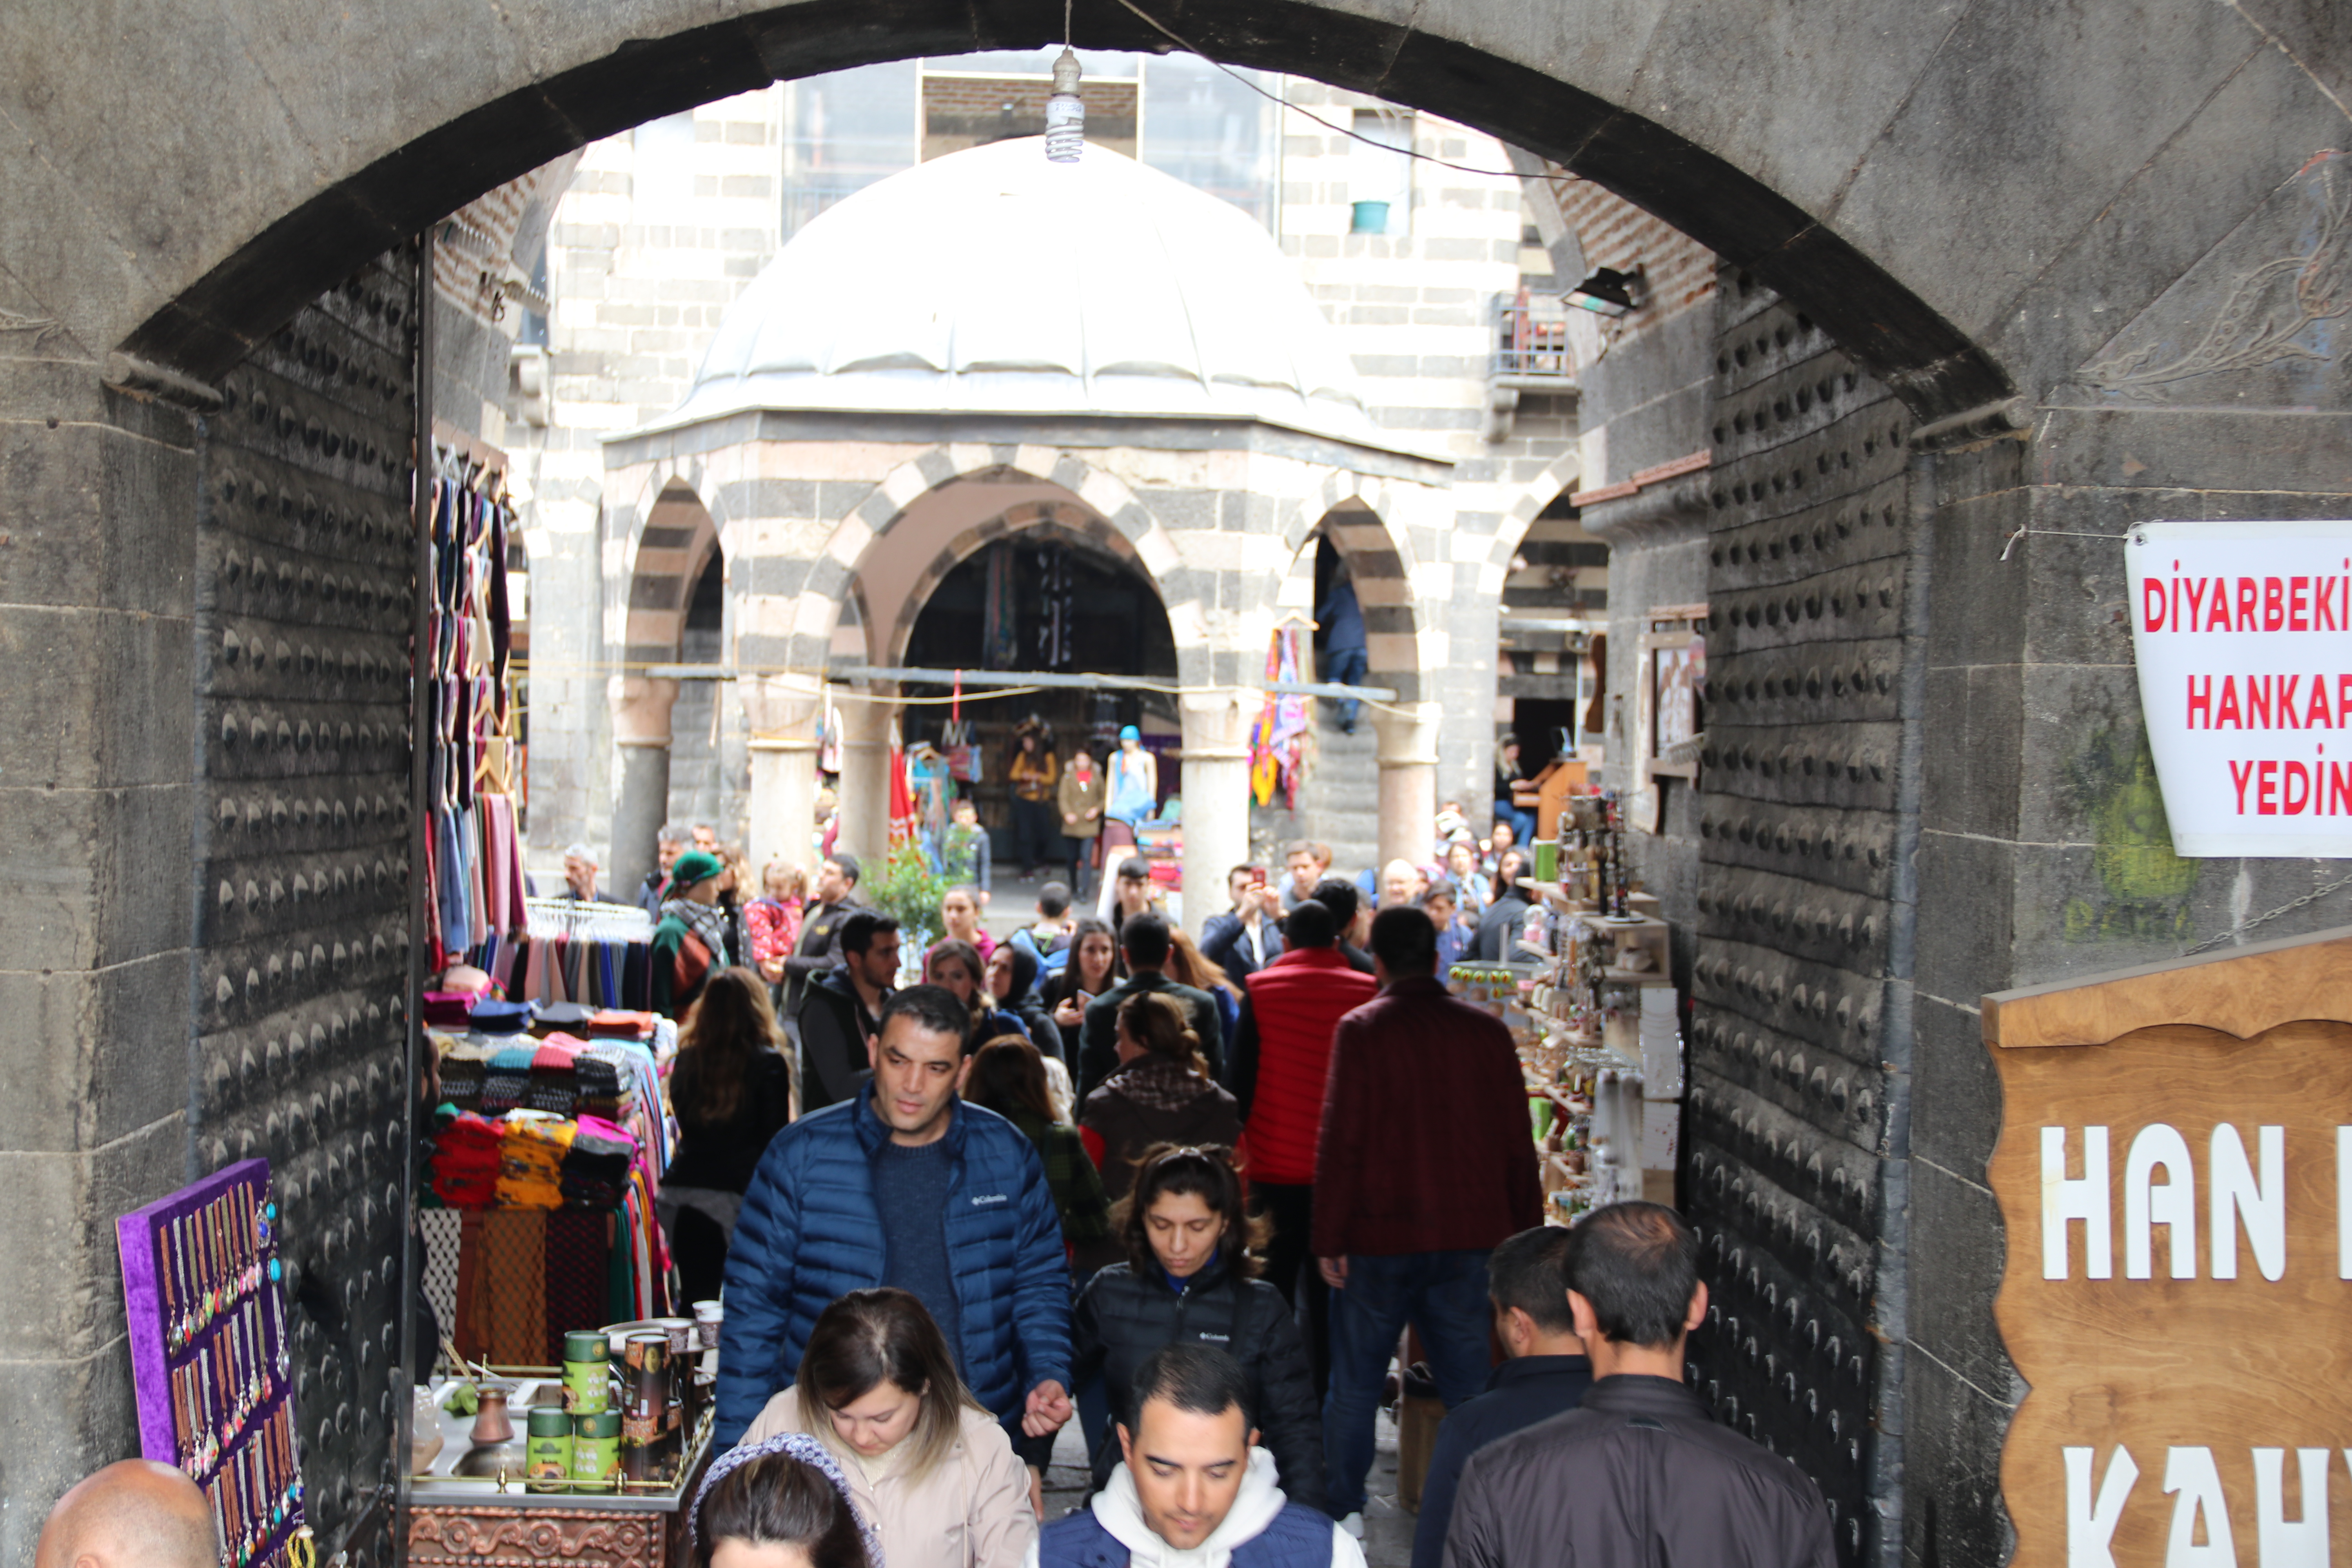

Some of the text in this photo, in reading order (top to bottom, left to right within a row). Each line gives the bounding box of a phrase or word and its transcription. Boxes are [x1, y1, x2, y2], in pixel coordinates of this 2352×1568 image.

[2143, 558, 2350, 633] DİYARBEKİ
[2229, 742, 2352, 816] YEDİN
[2041, 1122, 2286, 1282] HAN
[2061, 1443, 2352, 1568] KAH
